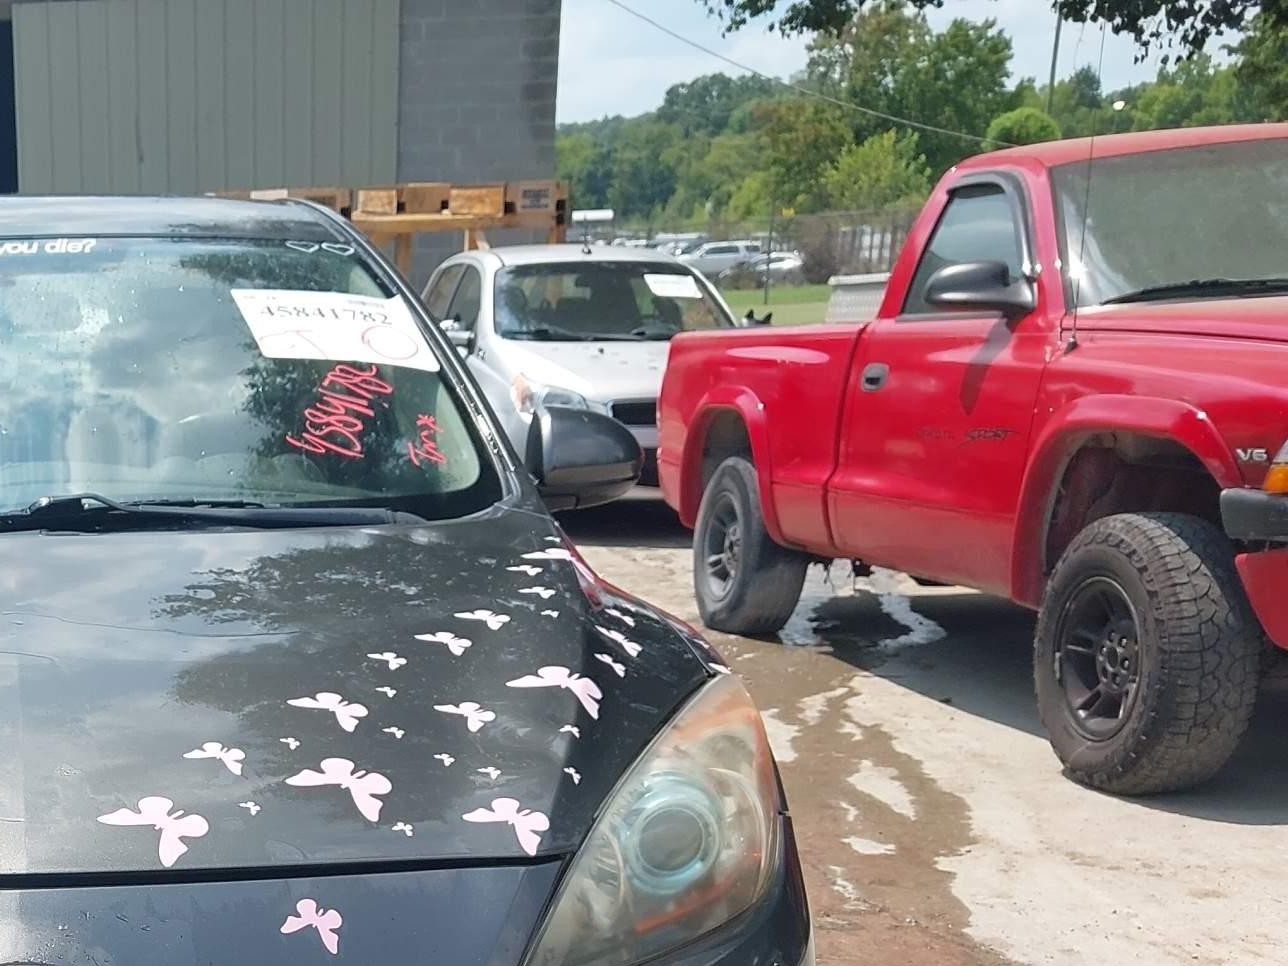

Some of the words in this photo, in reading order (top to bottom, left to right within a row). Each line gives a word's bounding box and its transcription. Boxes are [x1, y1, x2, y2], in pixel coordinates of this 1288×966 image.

[44, 238, 97, 254] die?
[261, 305, 392, 325] 45841782
[1235, 448, 1268, 462] V6
